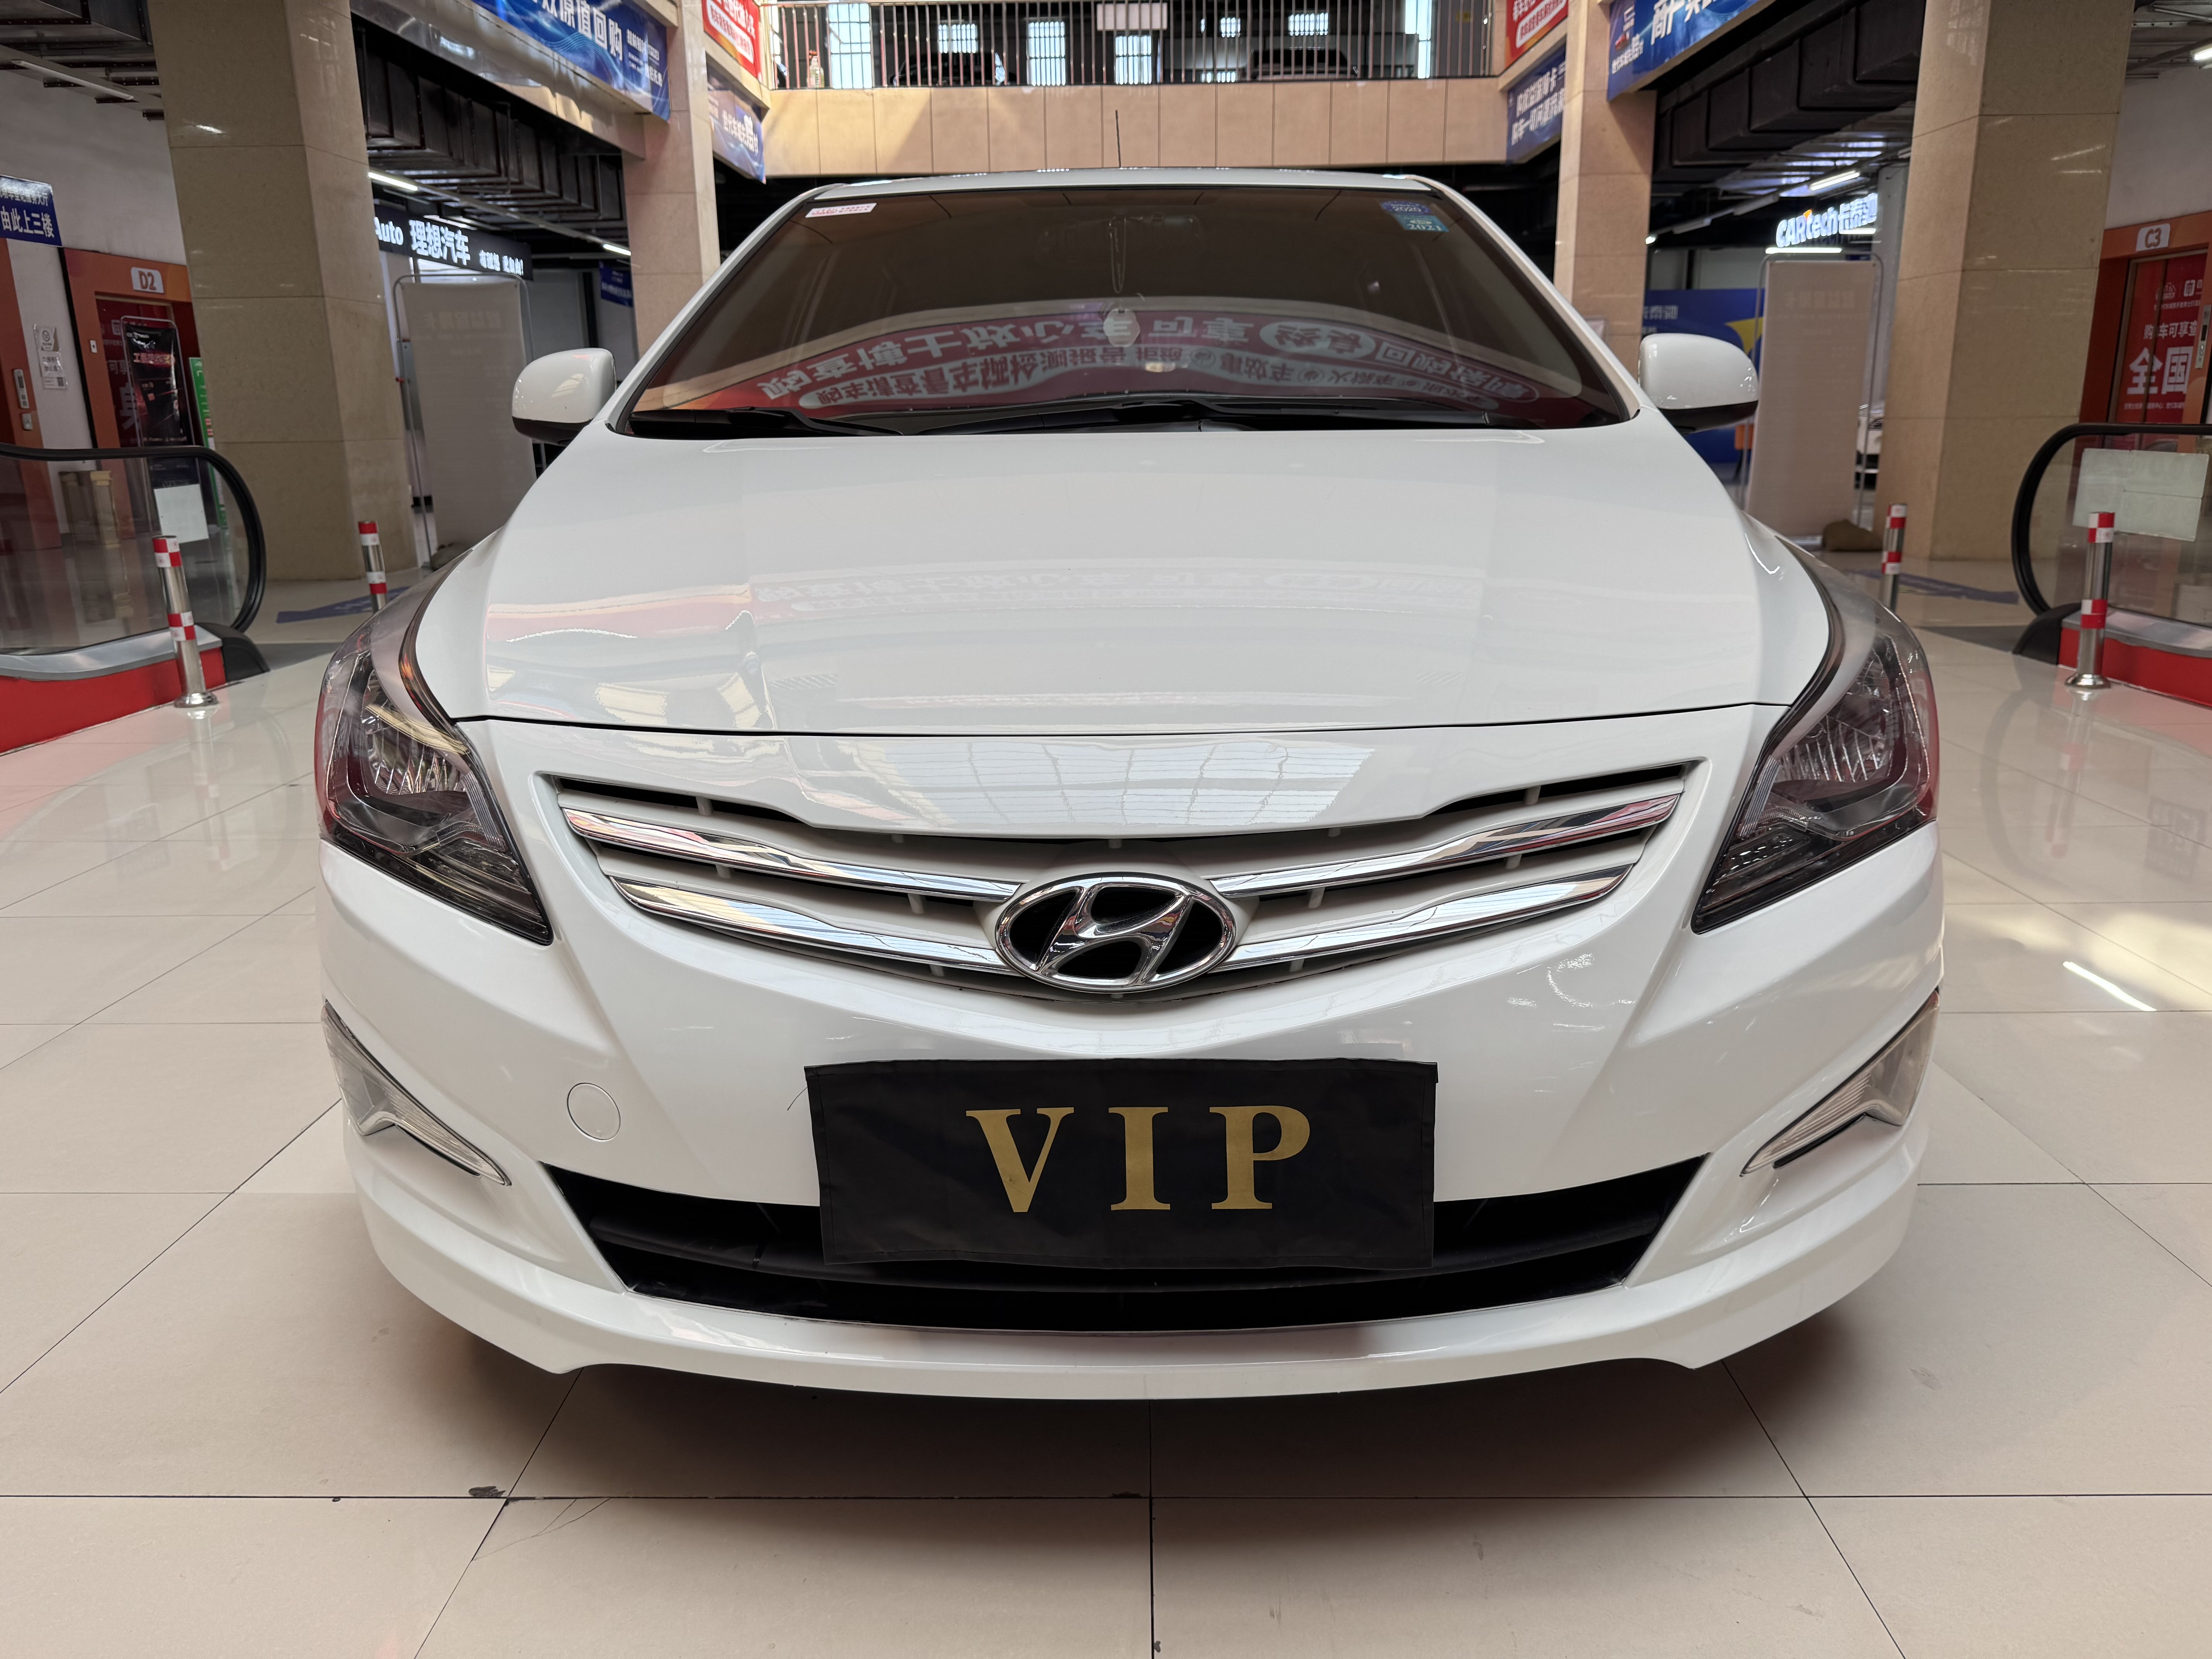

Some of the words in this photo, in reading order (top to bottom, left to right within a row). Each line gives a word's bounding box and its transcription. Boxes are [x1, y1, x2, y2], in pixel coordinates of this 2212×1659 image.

[0, 206, 55, 238] 由此上三楼
[374, 216, 404, 246] Auto
[409, 219, 471, 266] 理想汽车
[2145, 228, 2161, 248] C3
[138, 271, 156, 291] D2
[2126, 347, 2194, 395] 全国
[966, 1105, 1310, 1213] VIP
